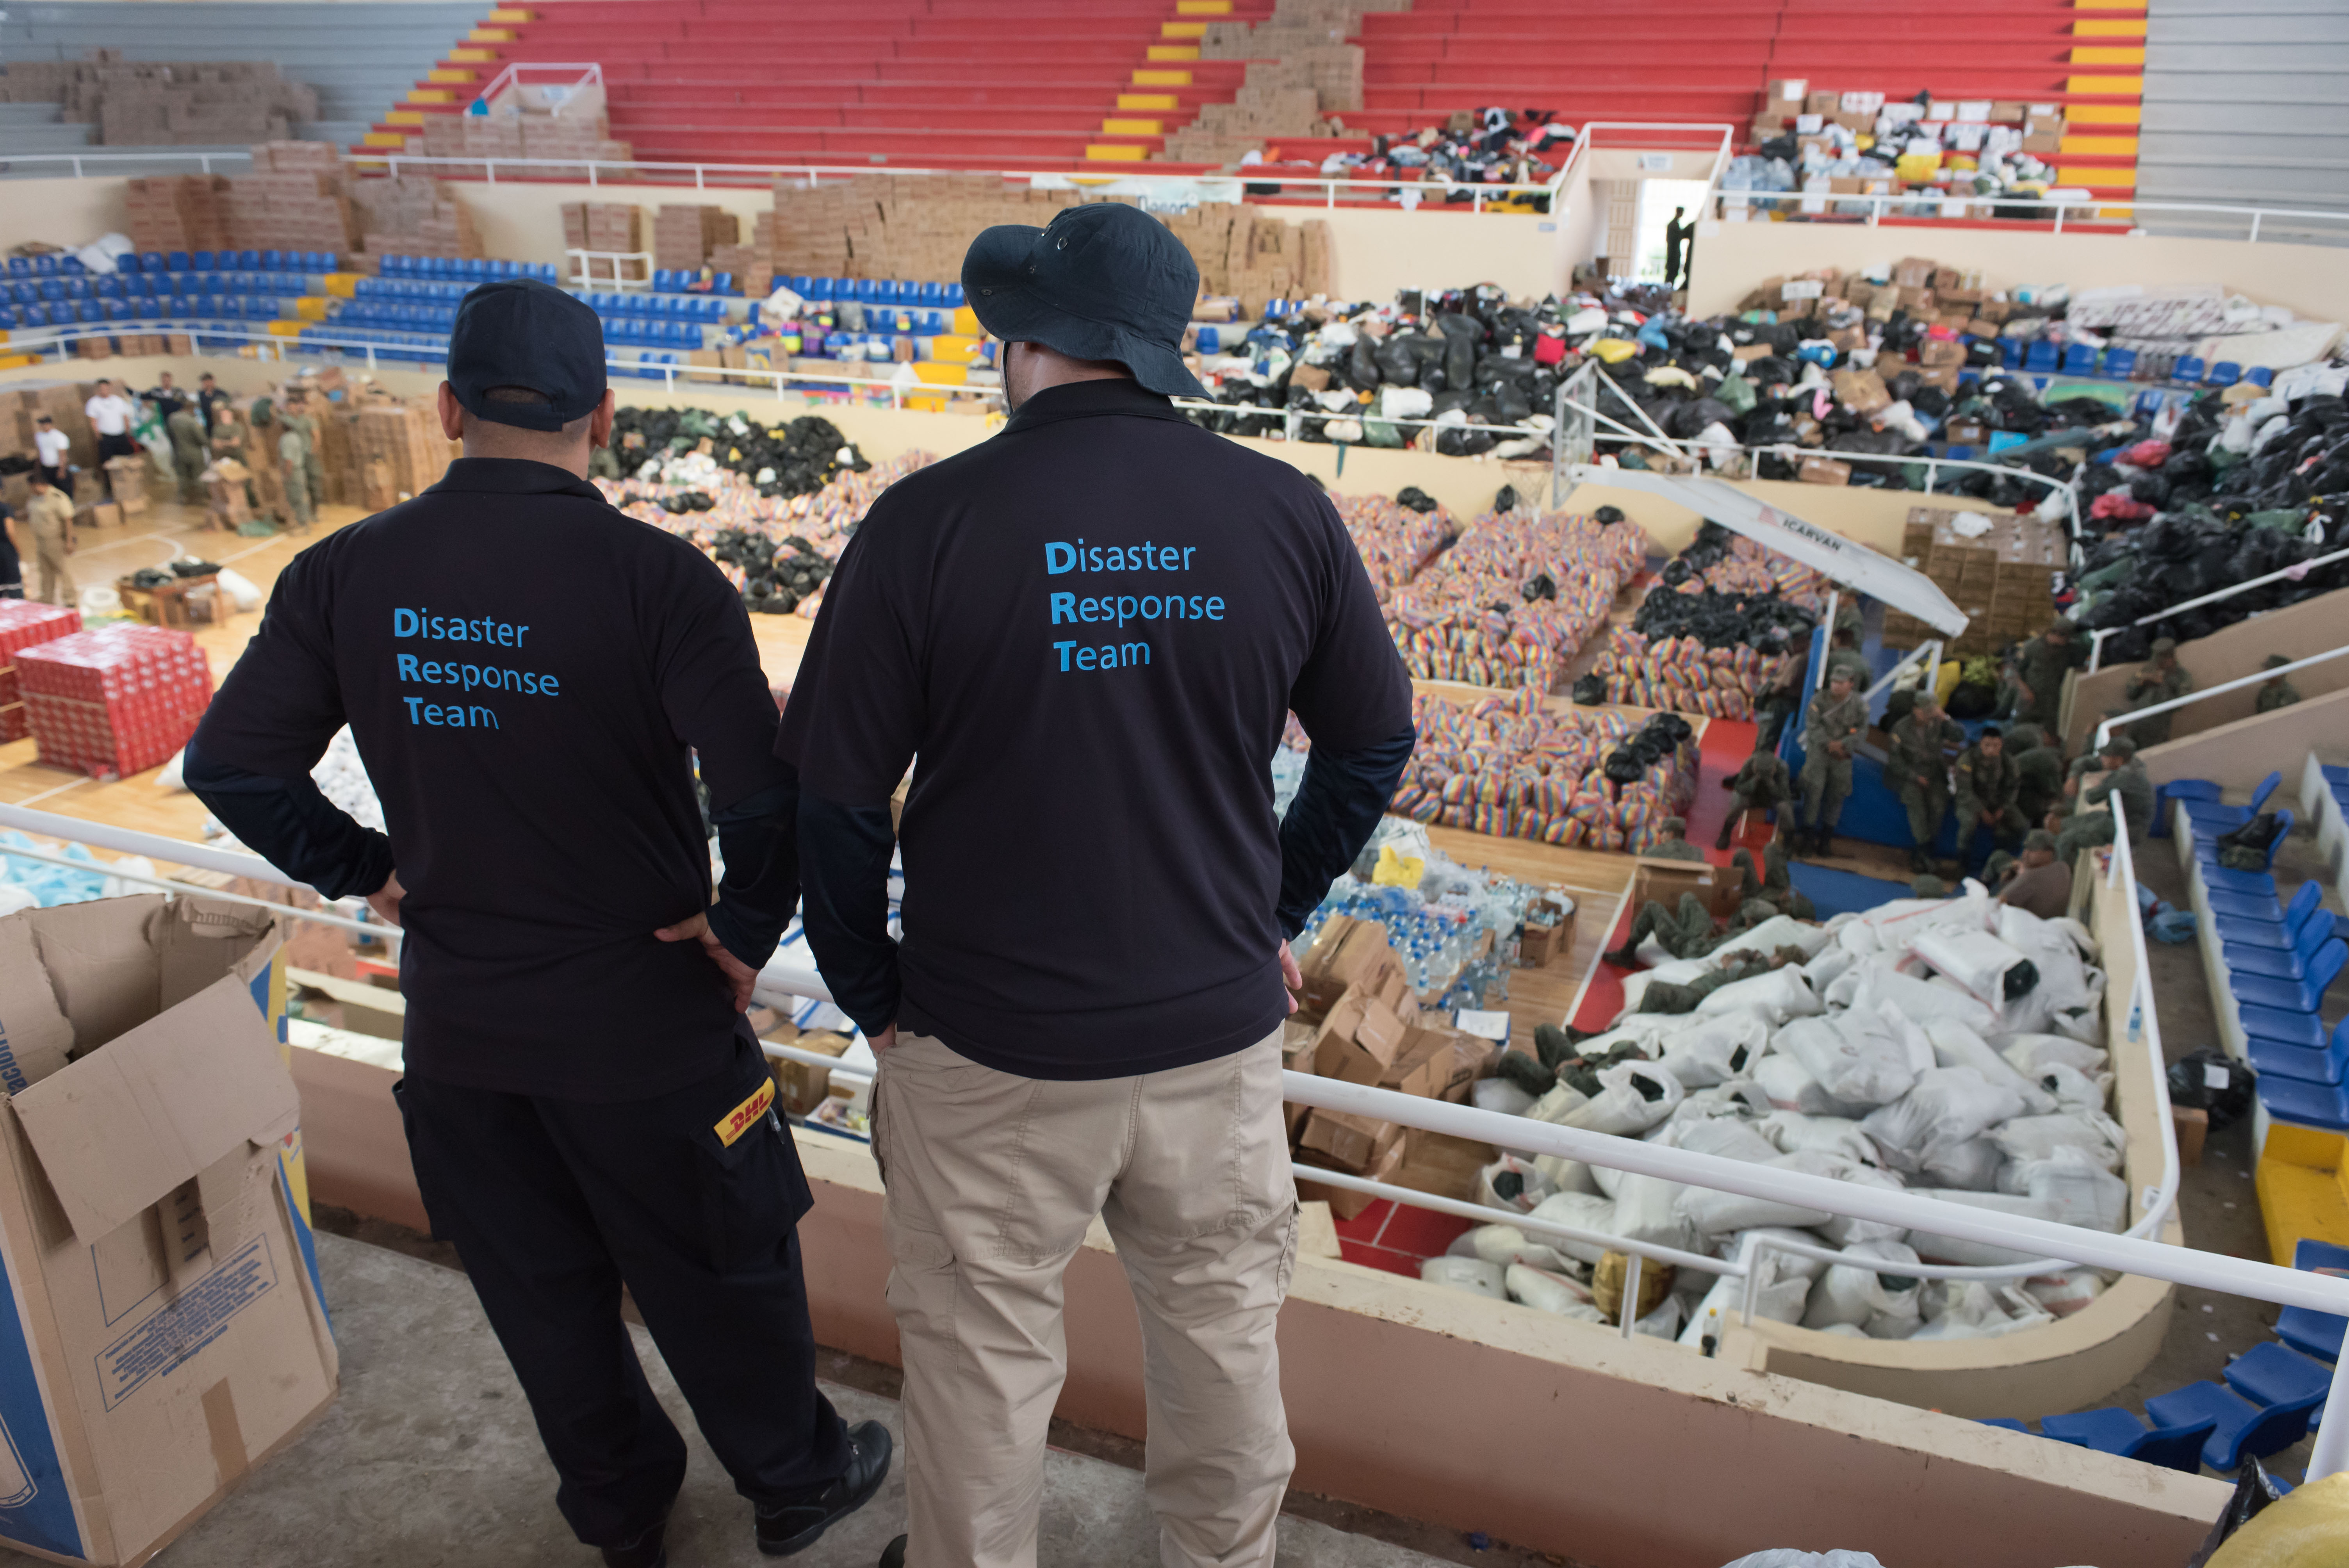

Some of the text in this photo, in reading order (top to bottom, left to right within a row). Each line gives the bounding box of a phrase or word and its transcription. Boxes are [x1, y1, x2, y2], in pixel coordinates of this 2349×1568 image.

[1783, 518, 1841, 551] ICARVAN
[1045, 538, 1196, 575] Disaster
[395, 607, 529, 648] Disaster
[1050, 592, 1225, 629] Response
[1053, 640, 1150, 672] Team
[397, 654, 559, 696] Response
[404, 697, 499, 729] Team
[729, 1092, 770, 1133] DHL
